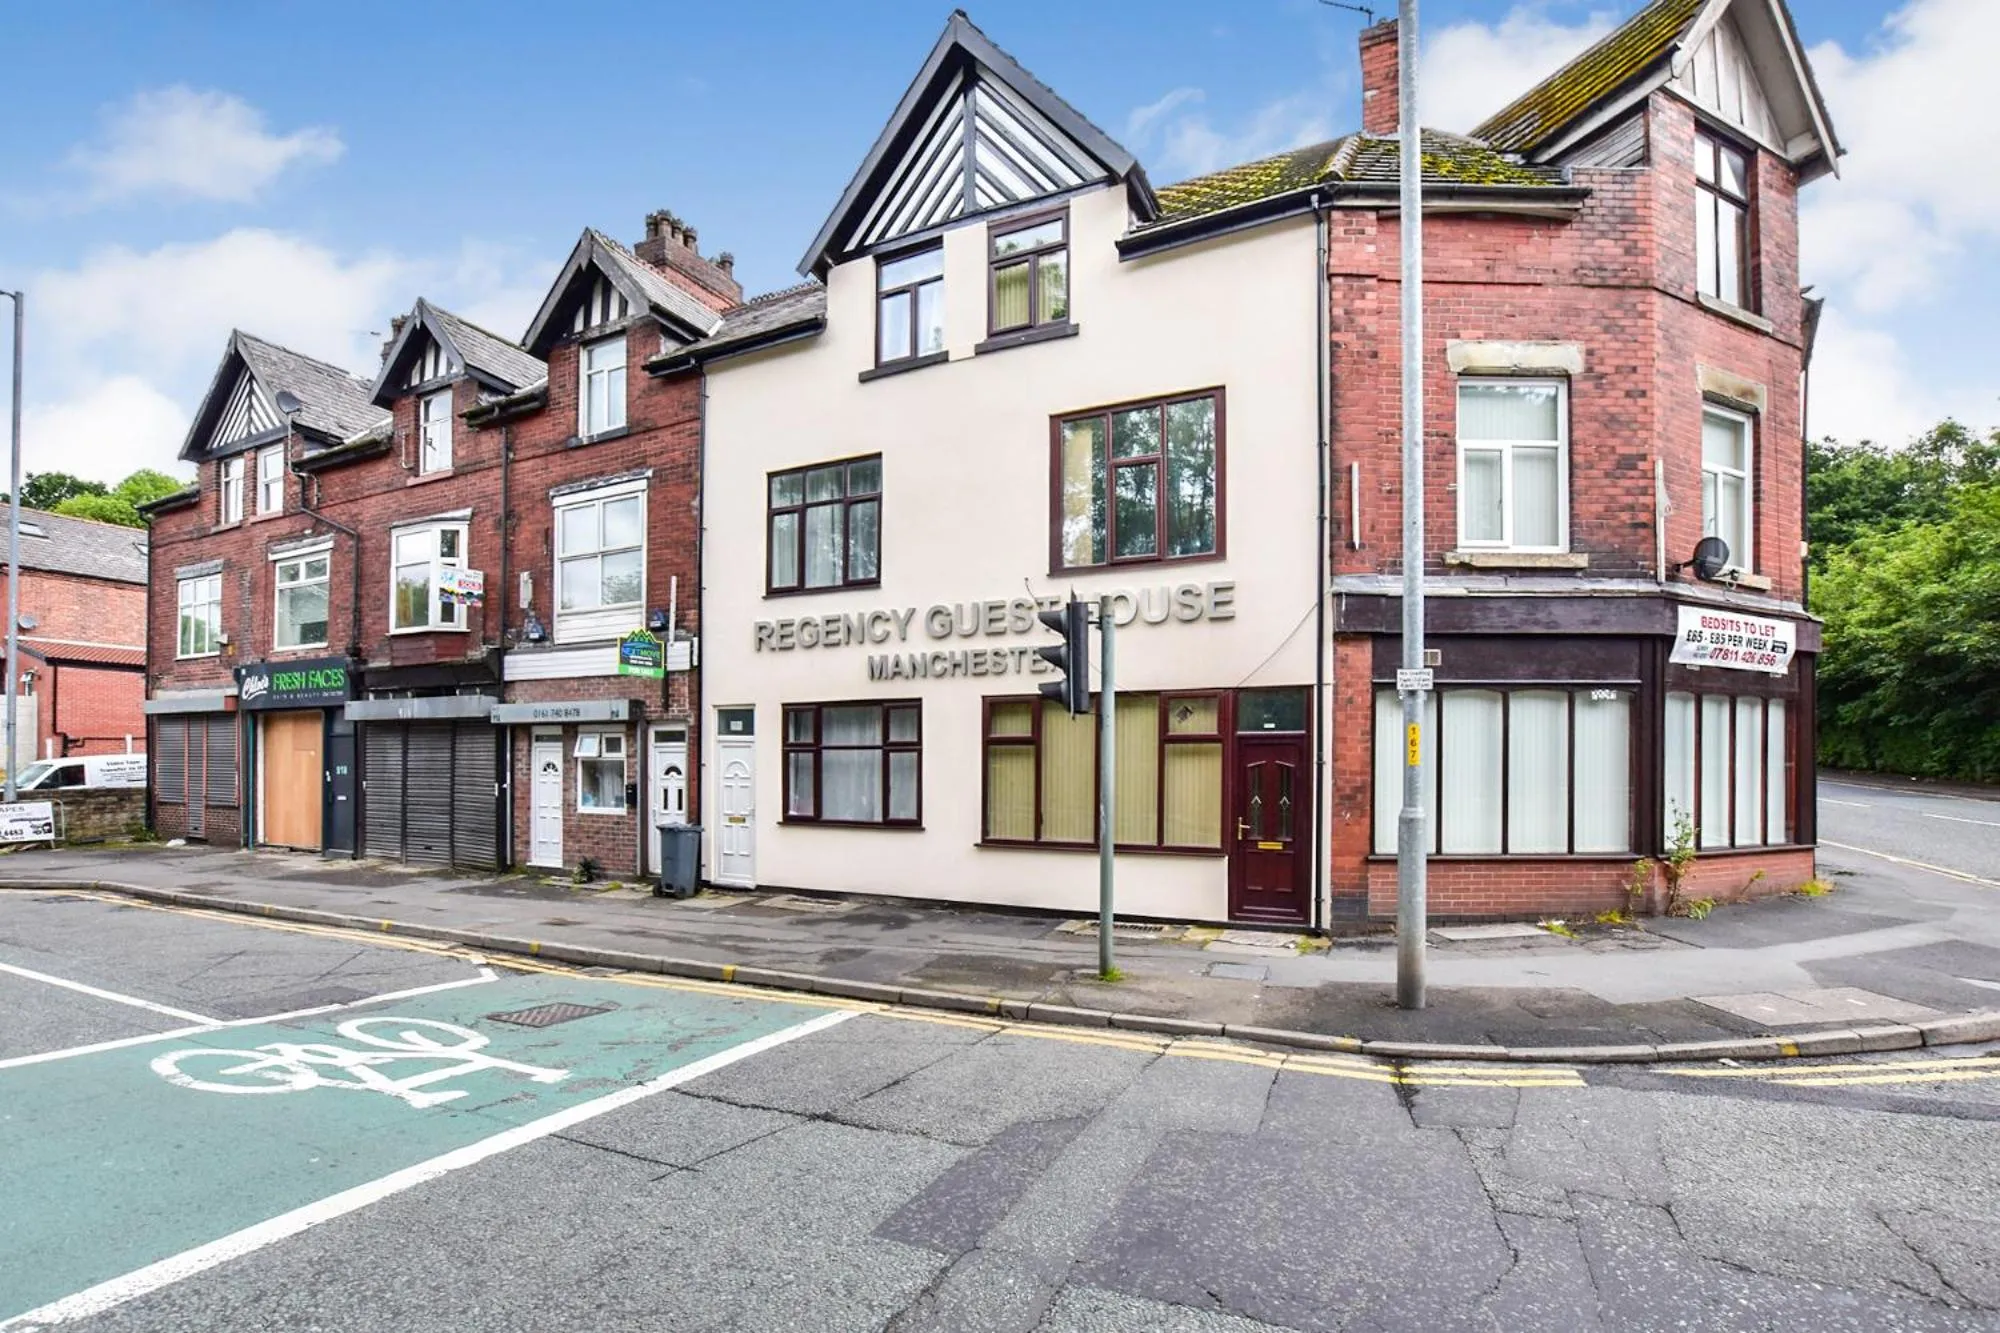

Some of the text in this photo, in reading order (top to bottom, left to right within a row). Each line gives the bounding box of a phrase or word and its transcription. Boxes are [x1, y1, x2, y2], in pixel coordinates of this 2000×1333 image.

[754, 607, 916, 651] REGENCY
[1701, 615, 1776, 637] BEDSITS TO LET
[1727, 635, 1744, 648] PER
[1745, 638, 1768, 650] WEEK
[868, 645, 1057, 681] MANCHESTE
[272, 671, 306, 691] FRESH
[309, 667, 344, 689] FACES
